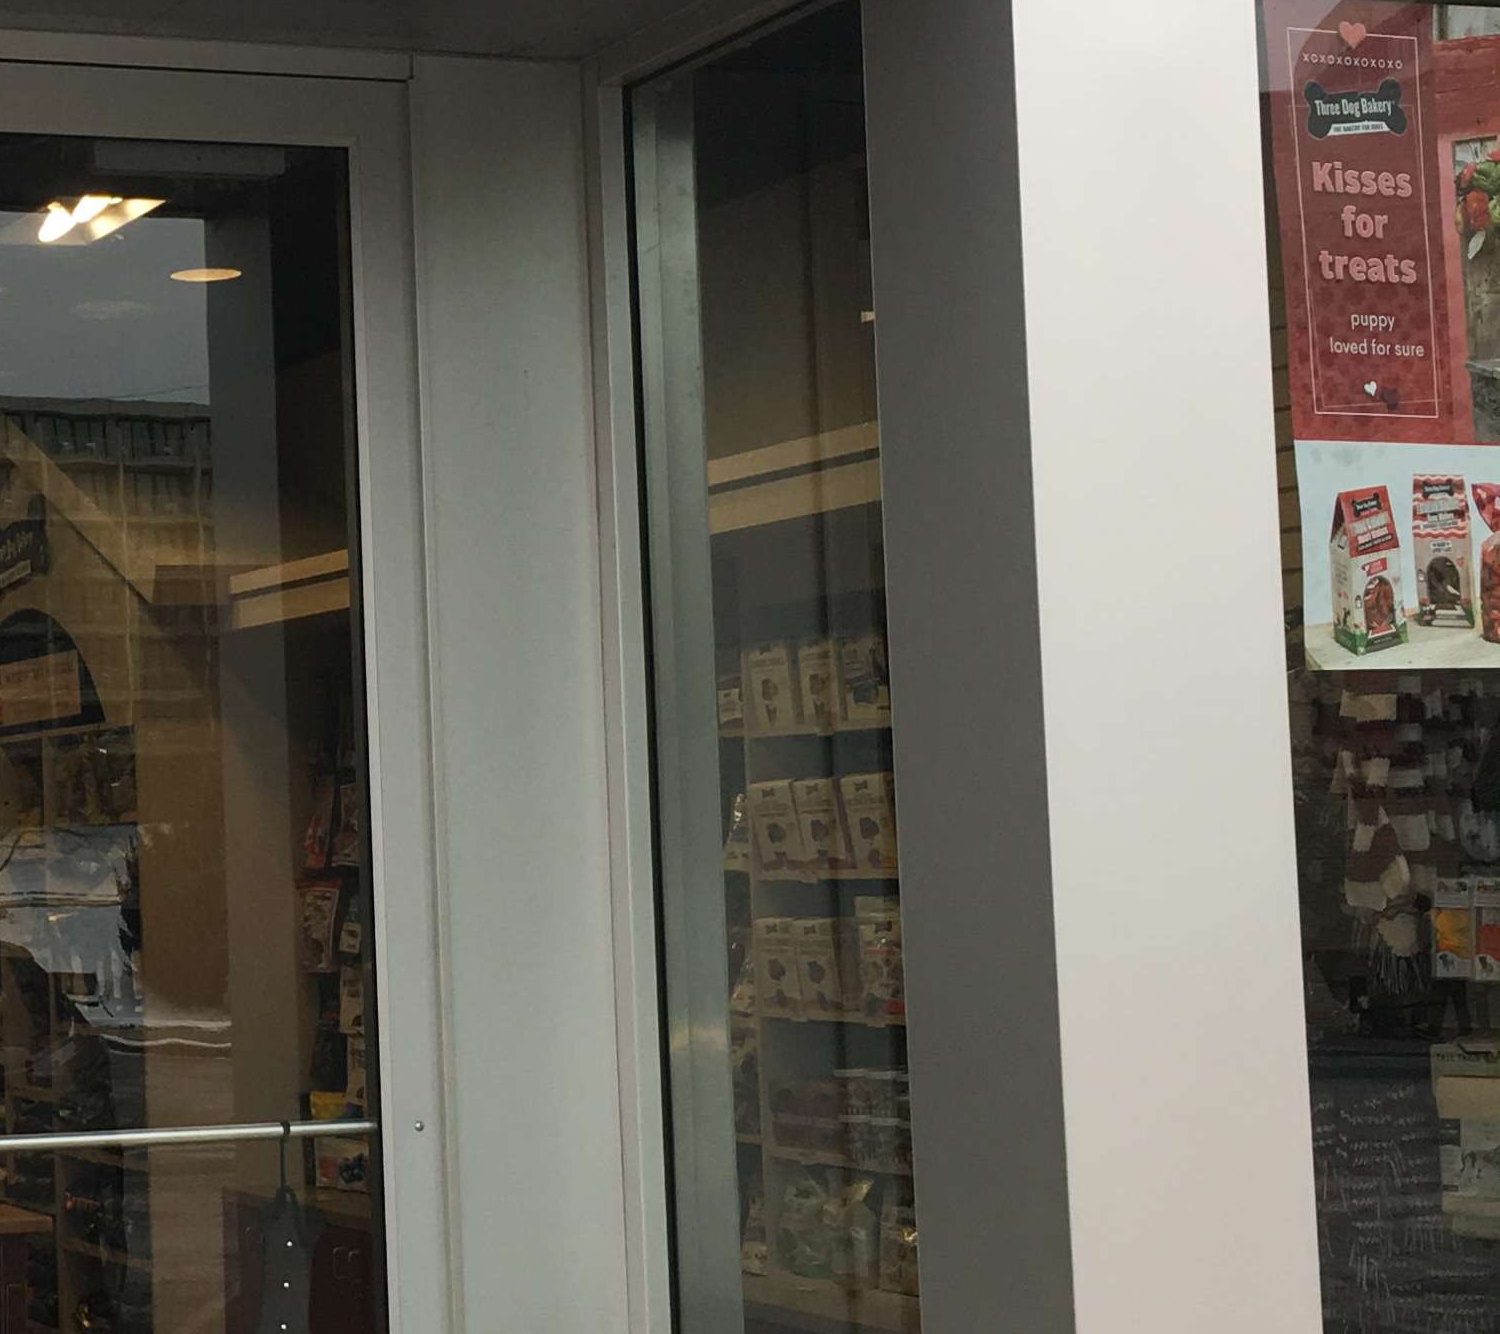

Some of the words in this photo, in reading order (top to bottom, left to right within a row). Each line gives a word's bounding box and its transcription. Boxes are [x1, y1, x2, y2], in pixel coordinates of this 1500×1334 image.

[1313, 99, 1341, 116] Three
[1341, 98, 1361, 118] Dog
[1361, 97, 1392, 116] Bakery
[1312, 161, 1413, 198] Kisses
[1341, 205, 1389, 239] for
[1319, 250, 1417, 284] treats
[1350, 313, 1395, 332] puppy
[1329, 336, 1368, 355] loved
[1371, 338, 1391, 356] for
[1395, 344, 1425, 357] sure
